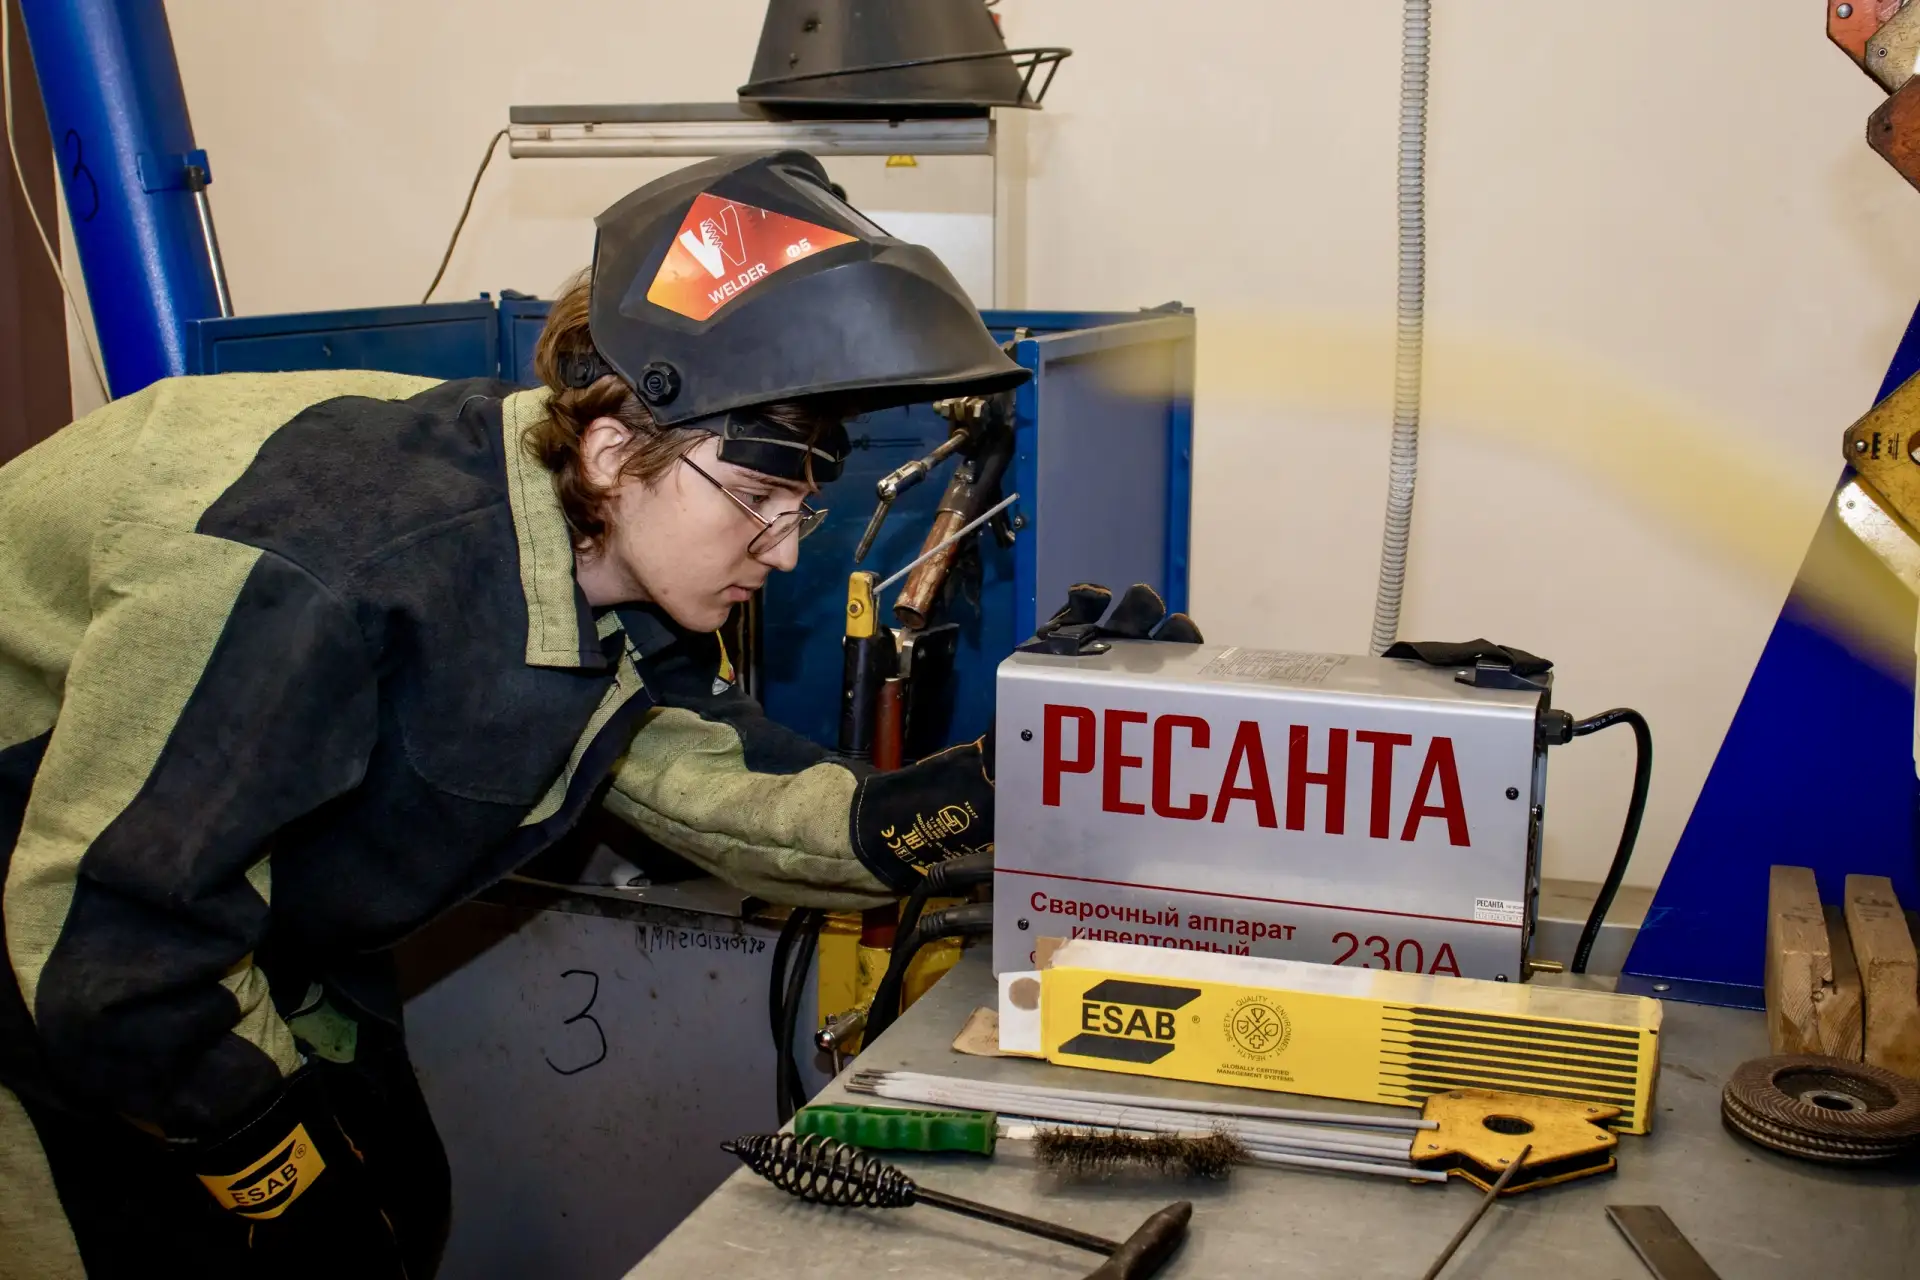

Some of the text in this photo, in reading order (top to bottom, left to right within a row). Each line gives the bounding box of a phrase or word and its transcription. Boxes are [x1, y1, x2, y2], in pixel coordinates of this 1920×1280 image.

[708, 262, 769, 304] WELDER
[1042, 703, 1471, 847] РЕСАНТА
[1031, 891, 1297, 942] Сварочный аппарат
[545, 970, 607, 1075] 3
[1082, 1002, 1176, 1041] ESAB
[1223, 995, 1292, 1062] QUALITY ENVIRONMENT HEALTH SAFETY
[1216, 1068, 1295, 1082] MANAGEMENT SYSTEMS
[1221, 1063, 1290, 1076] GLOBALLY CERTIFIED
[231, 1163, 299, 1206] ESAB
